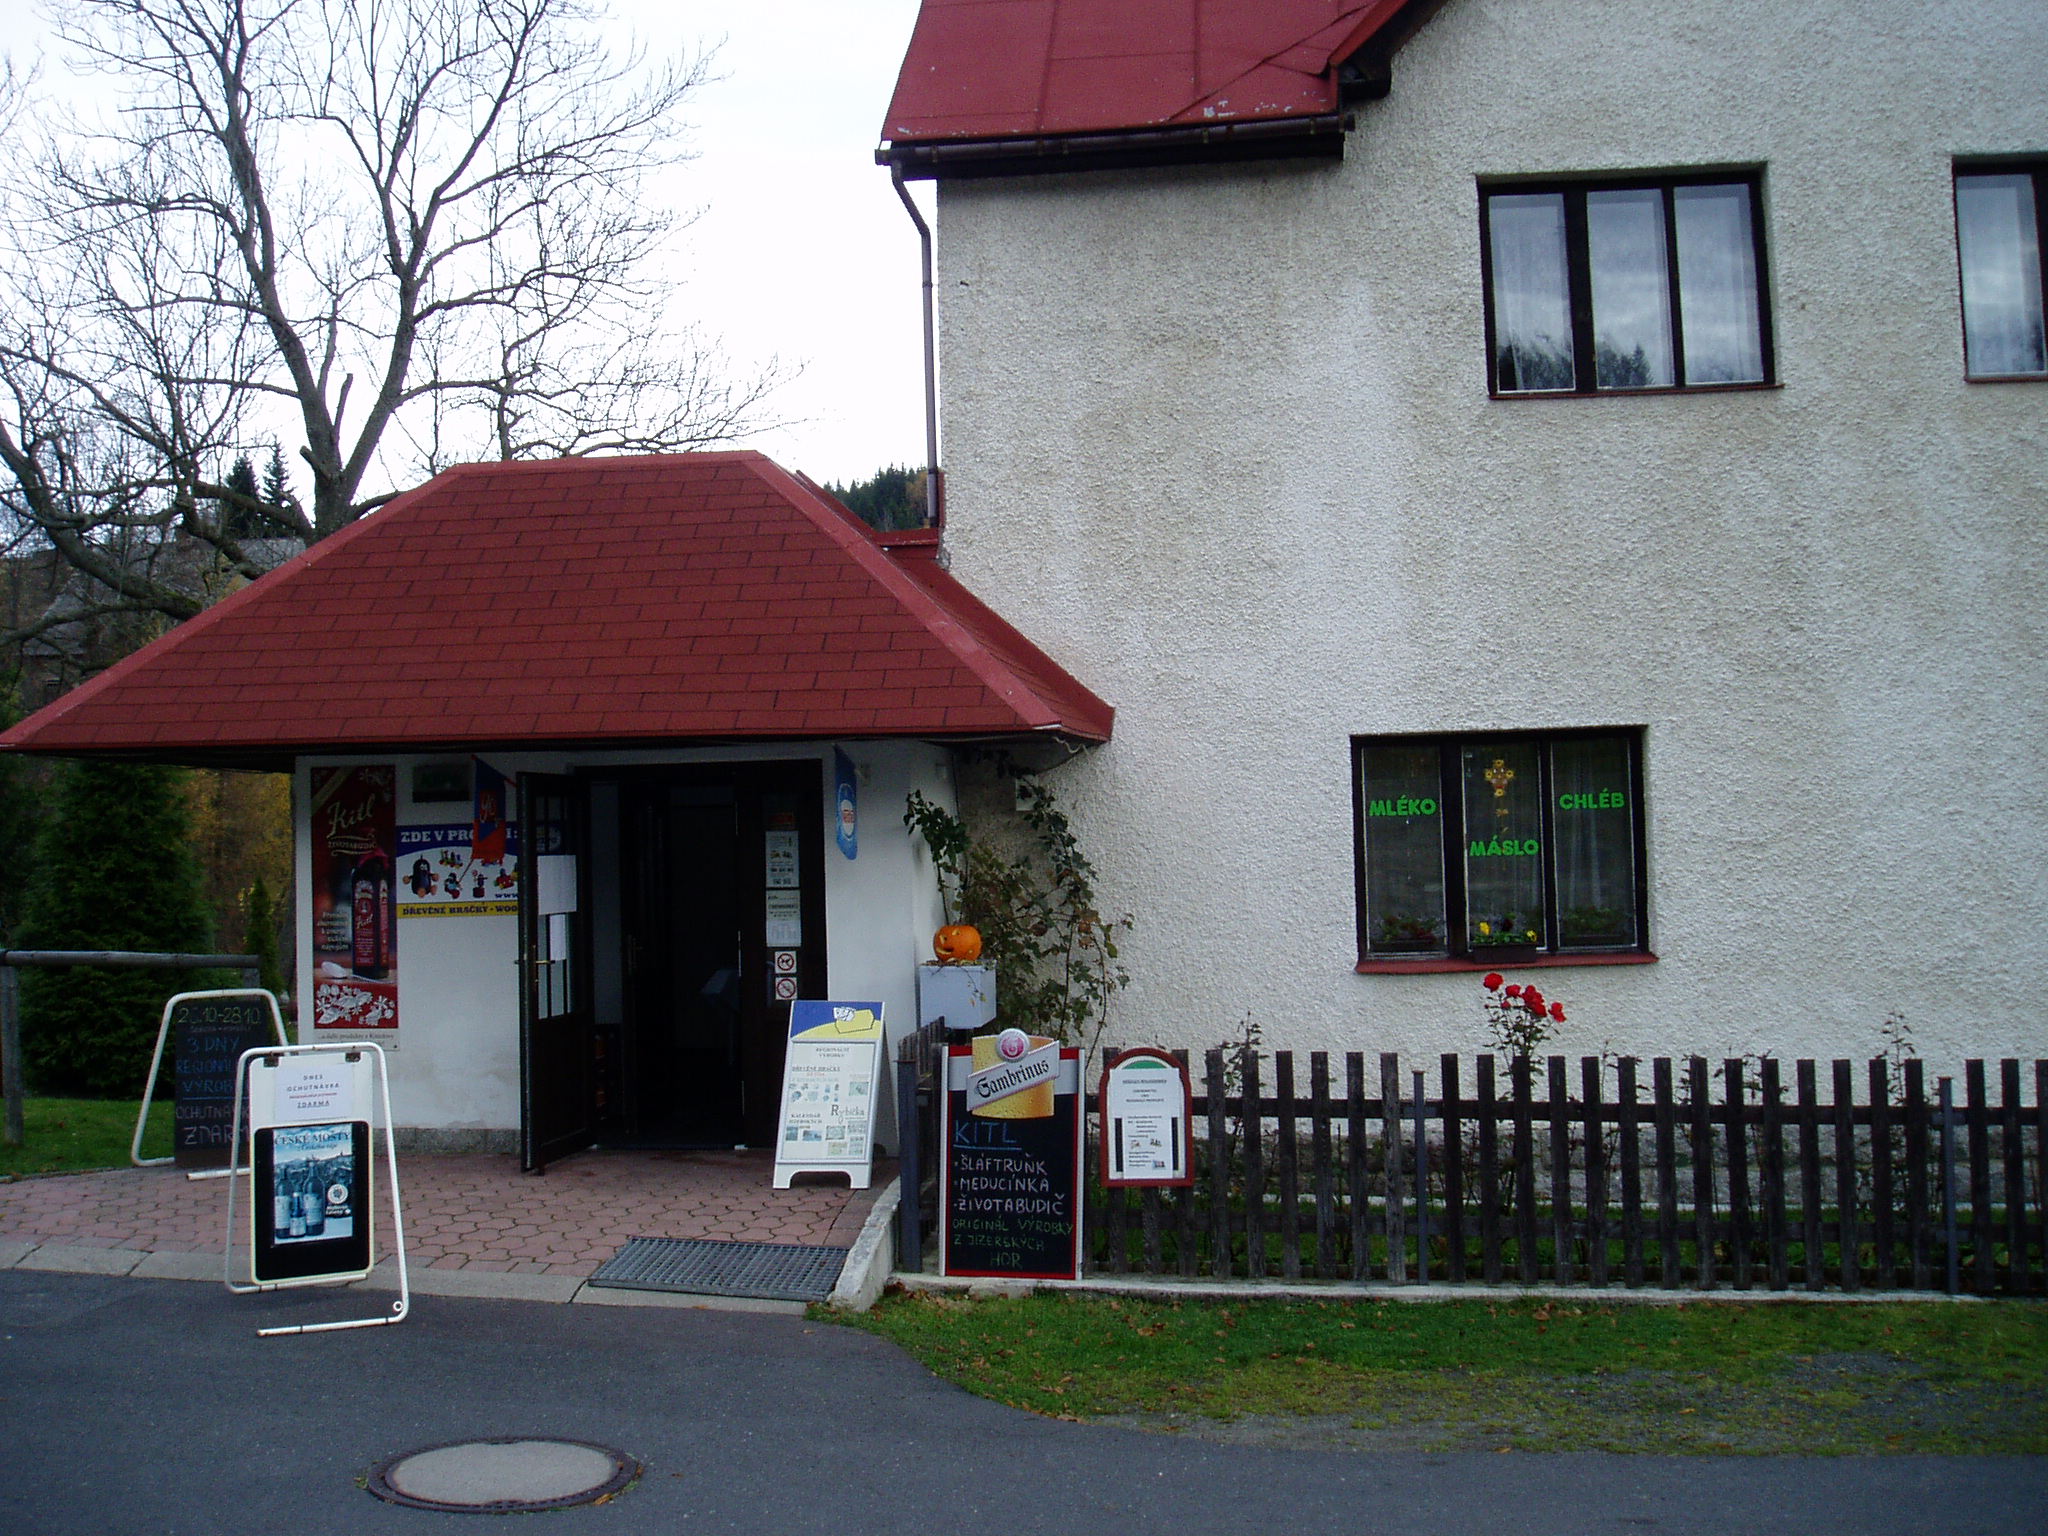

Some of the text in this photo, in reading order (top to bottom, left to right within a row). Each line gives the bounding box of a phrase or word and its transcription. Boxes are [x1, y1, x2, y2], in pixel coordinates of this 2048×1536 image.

[1369, 795, 1437, 816] MLÉKO
[1559, 788, 1625, 811] CHLÉB
[327, 793, 376, 838] Kitl
[400, 830, 432, 843] ZDE
[434, 829, 444, 841] V
[1470, 835, 1539, 857] MÁSLO
[976, 1060, 1050, 1098] Gambrinus
[956, 1120, 1017, 1144] KITL
[960, 1173, 1050, 1193] MEDUCÍNKA
[958, 1193, 1066, 1215] ŽIVOTABUDIČ
[990, 1251, 1023, 1268] HOR
